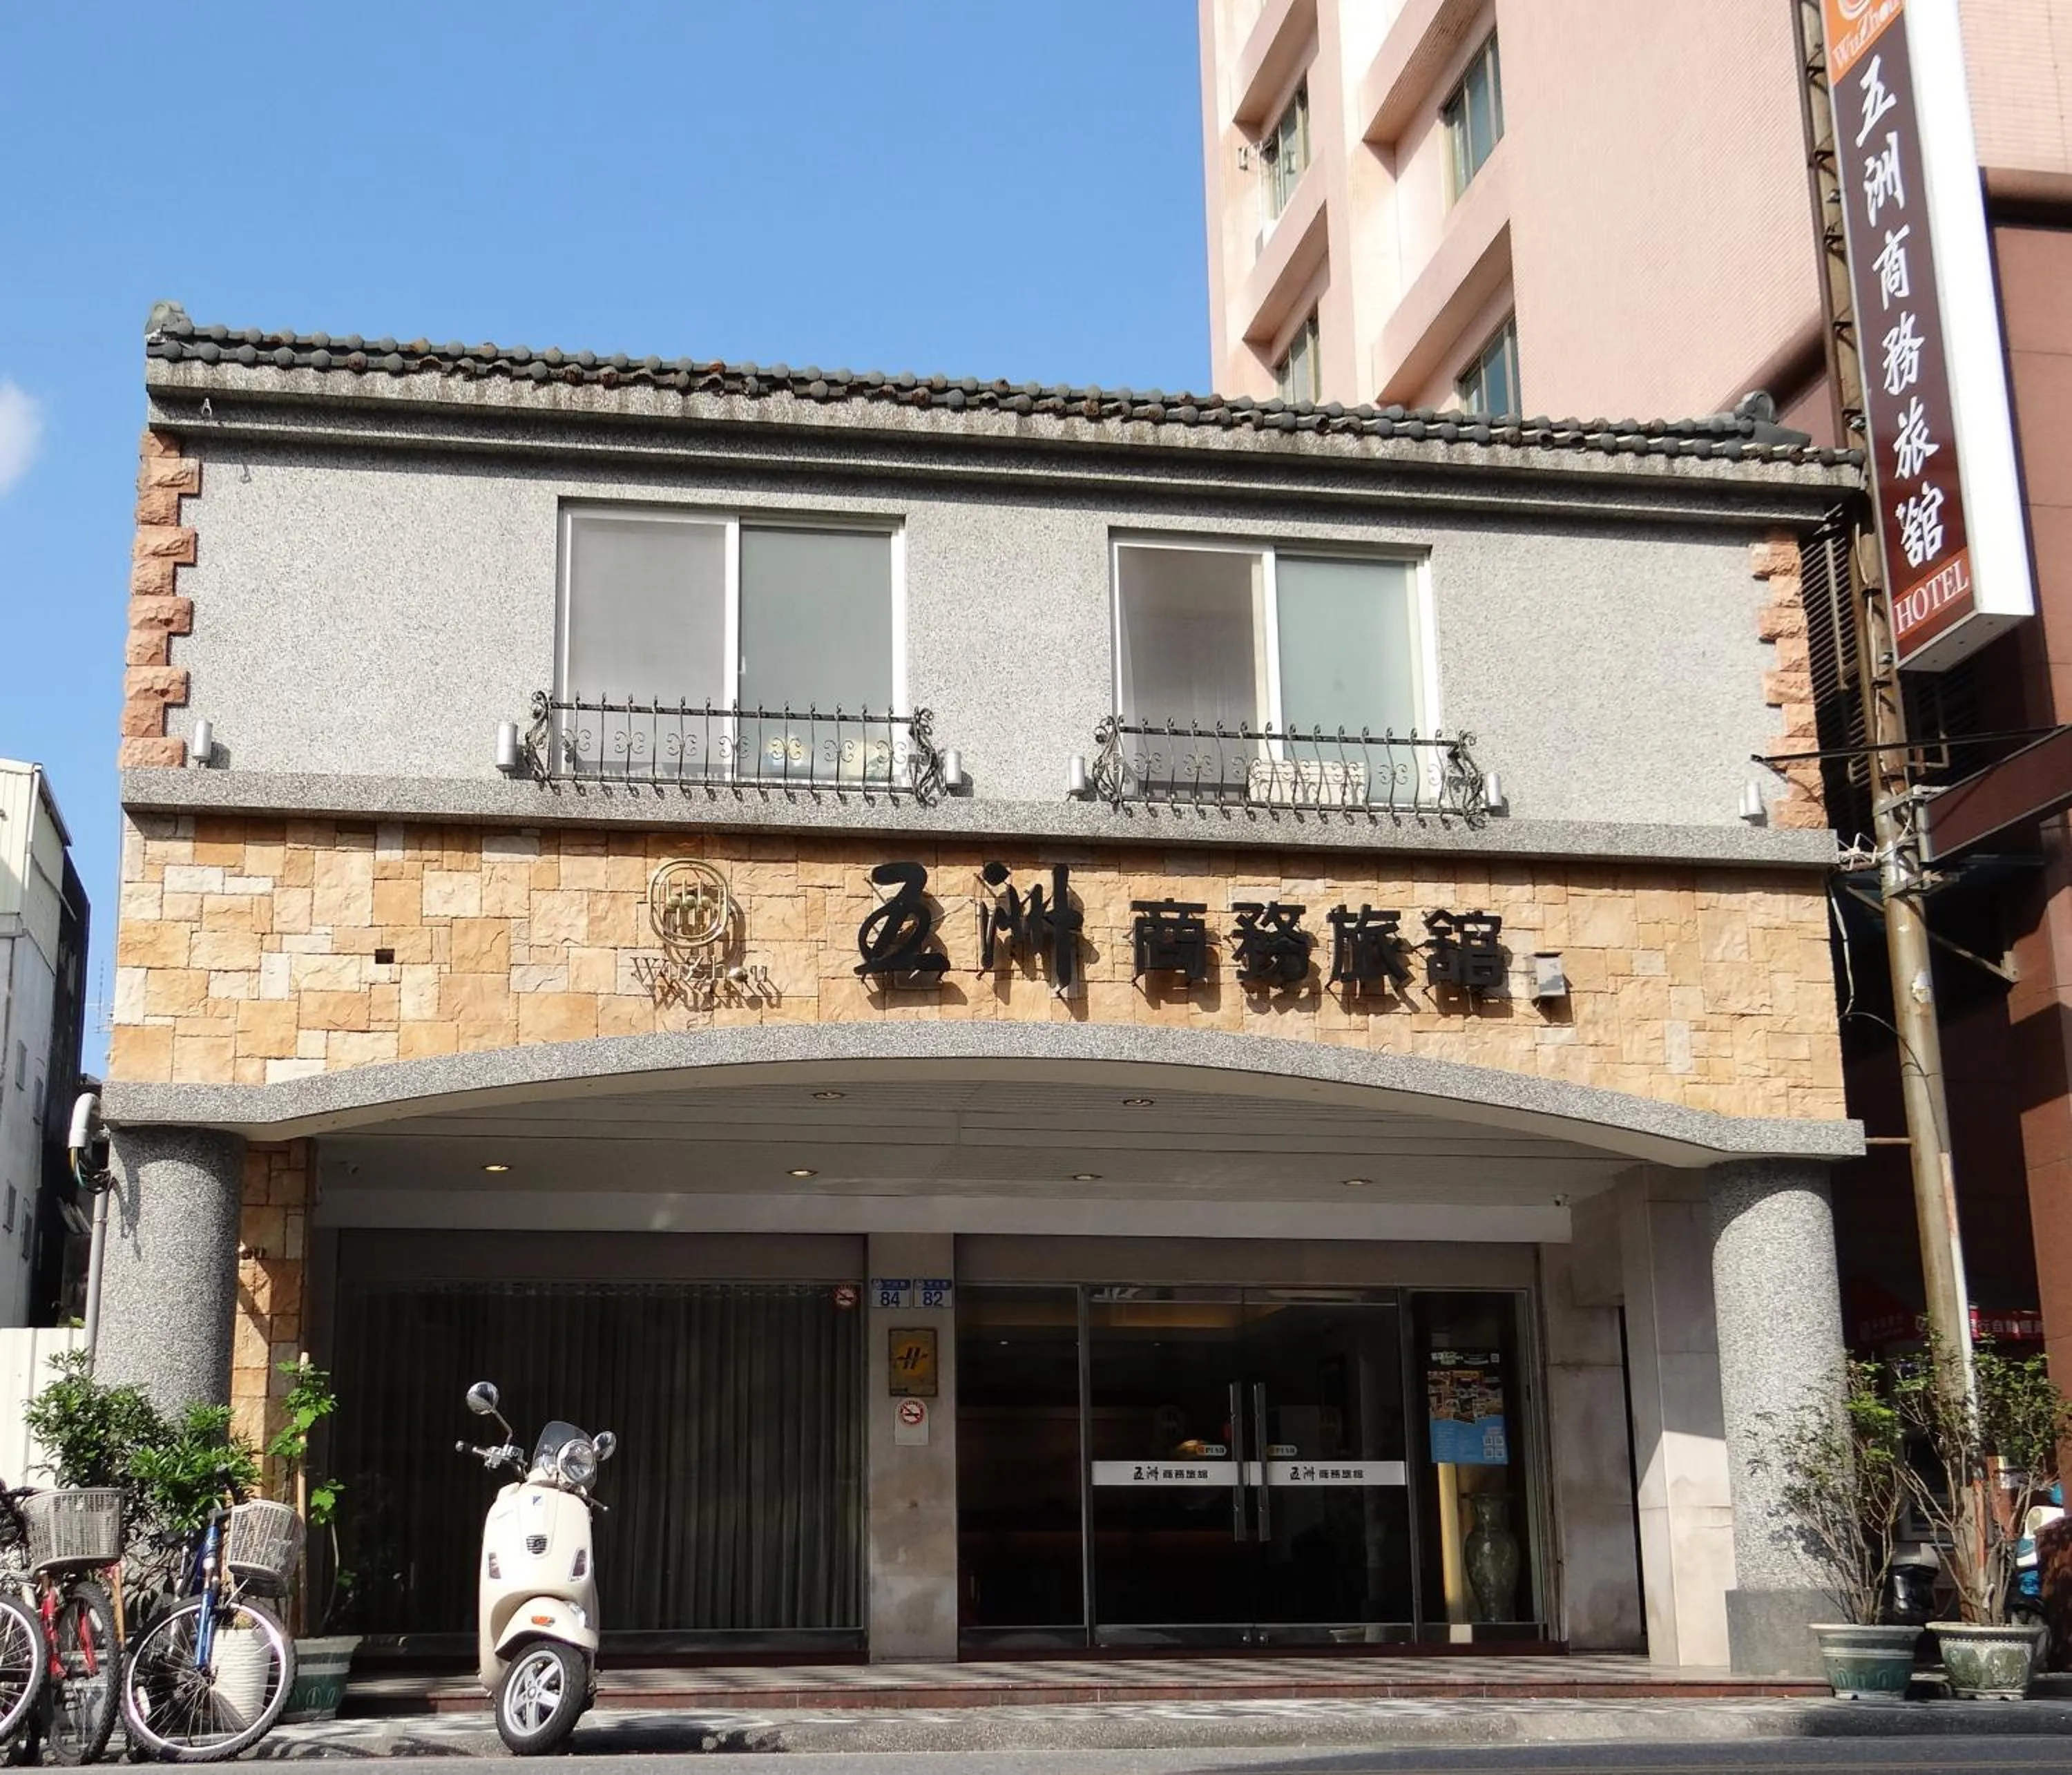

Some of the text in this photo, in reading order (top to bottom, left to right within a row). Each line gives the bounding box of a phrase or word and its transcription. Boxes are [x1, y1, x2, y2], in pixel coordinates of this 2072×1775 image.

[1894, 559, 1969, 635] HOTEL
[881, 1292, 900, 1307] 84
[923, 1292, 943, 1307] 82
